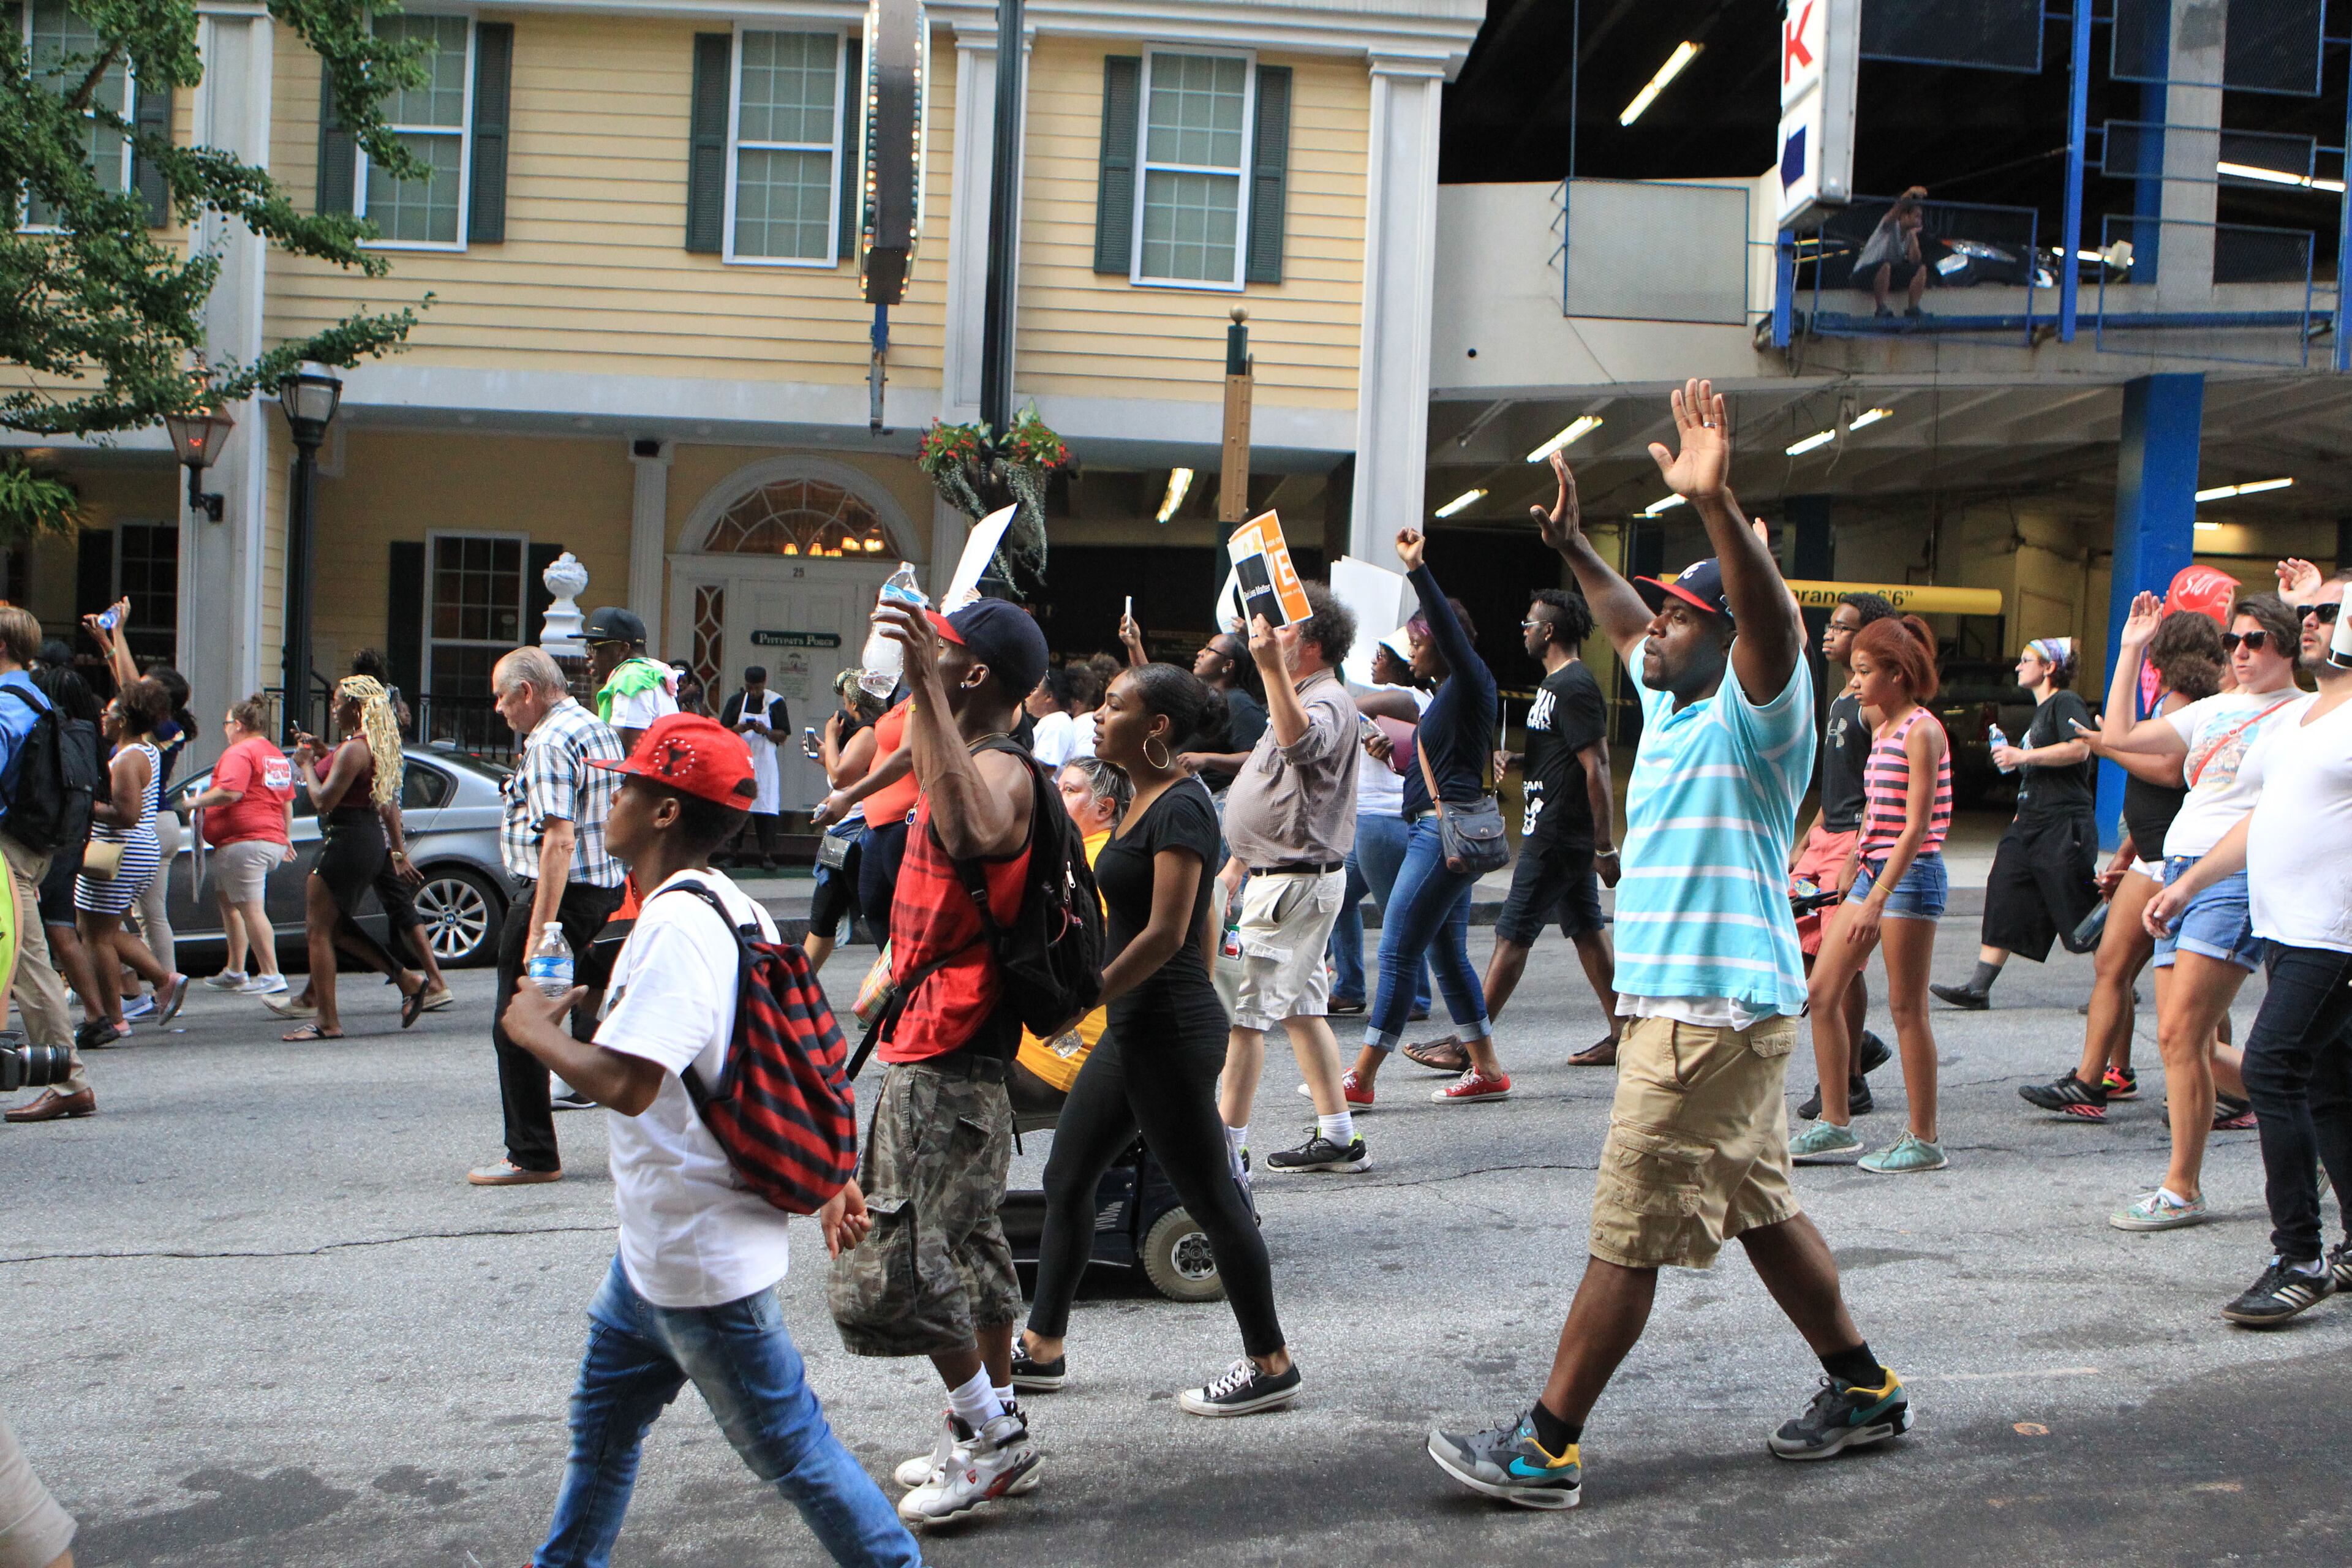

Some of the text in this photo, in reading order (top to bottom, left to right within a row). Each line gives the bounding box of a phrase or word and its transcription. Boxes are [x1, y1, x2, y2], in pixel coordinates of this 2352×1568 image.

[1784, 0, 1813, 85] K
[793, 567, 804, 578] 25
[1255, 584, 1270, 595] Matter
